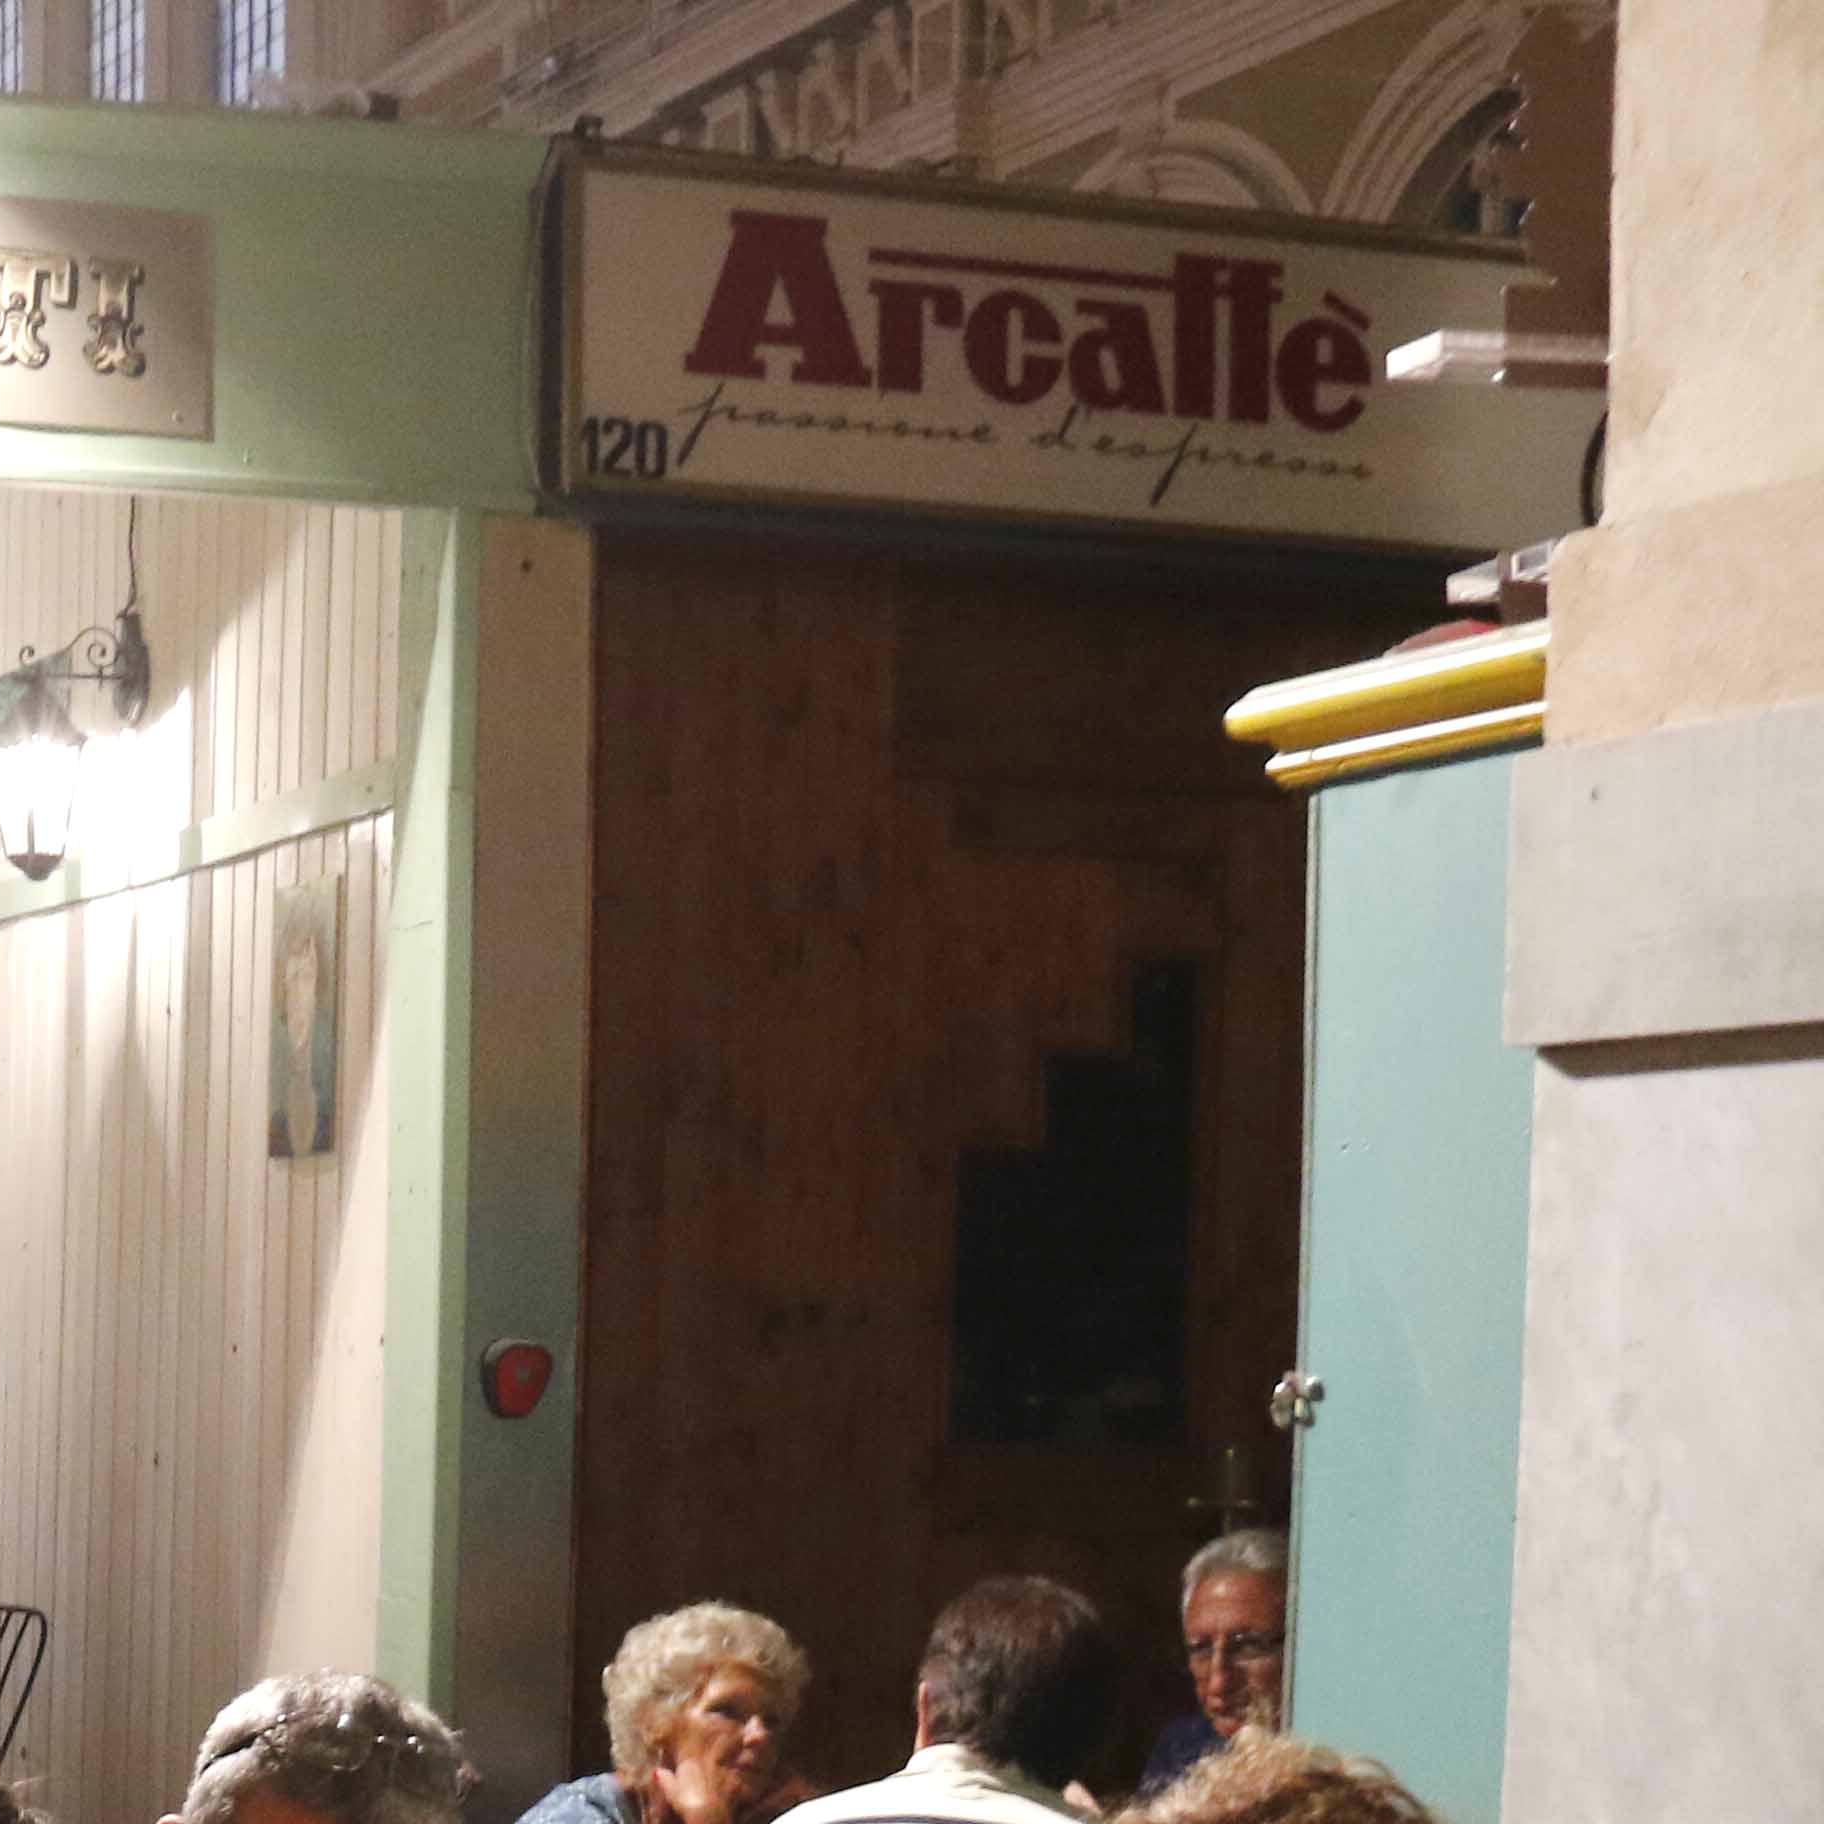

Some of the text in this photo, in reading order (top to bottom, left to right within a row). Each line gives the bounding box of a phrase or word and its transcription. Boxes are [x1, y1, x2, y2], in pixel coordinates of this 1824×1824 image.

[683, 209, 1373, 432] Arcaffè
[581, 415, 668, 480] 120
[675, 381, 997, 469] passione
